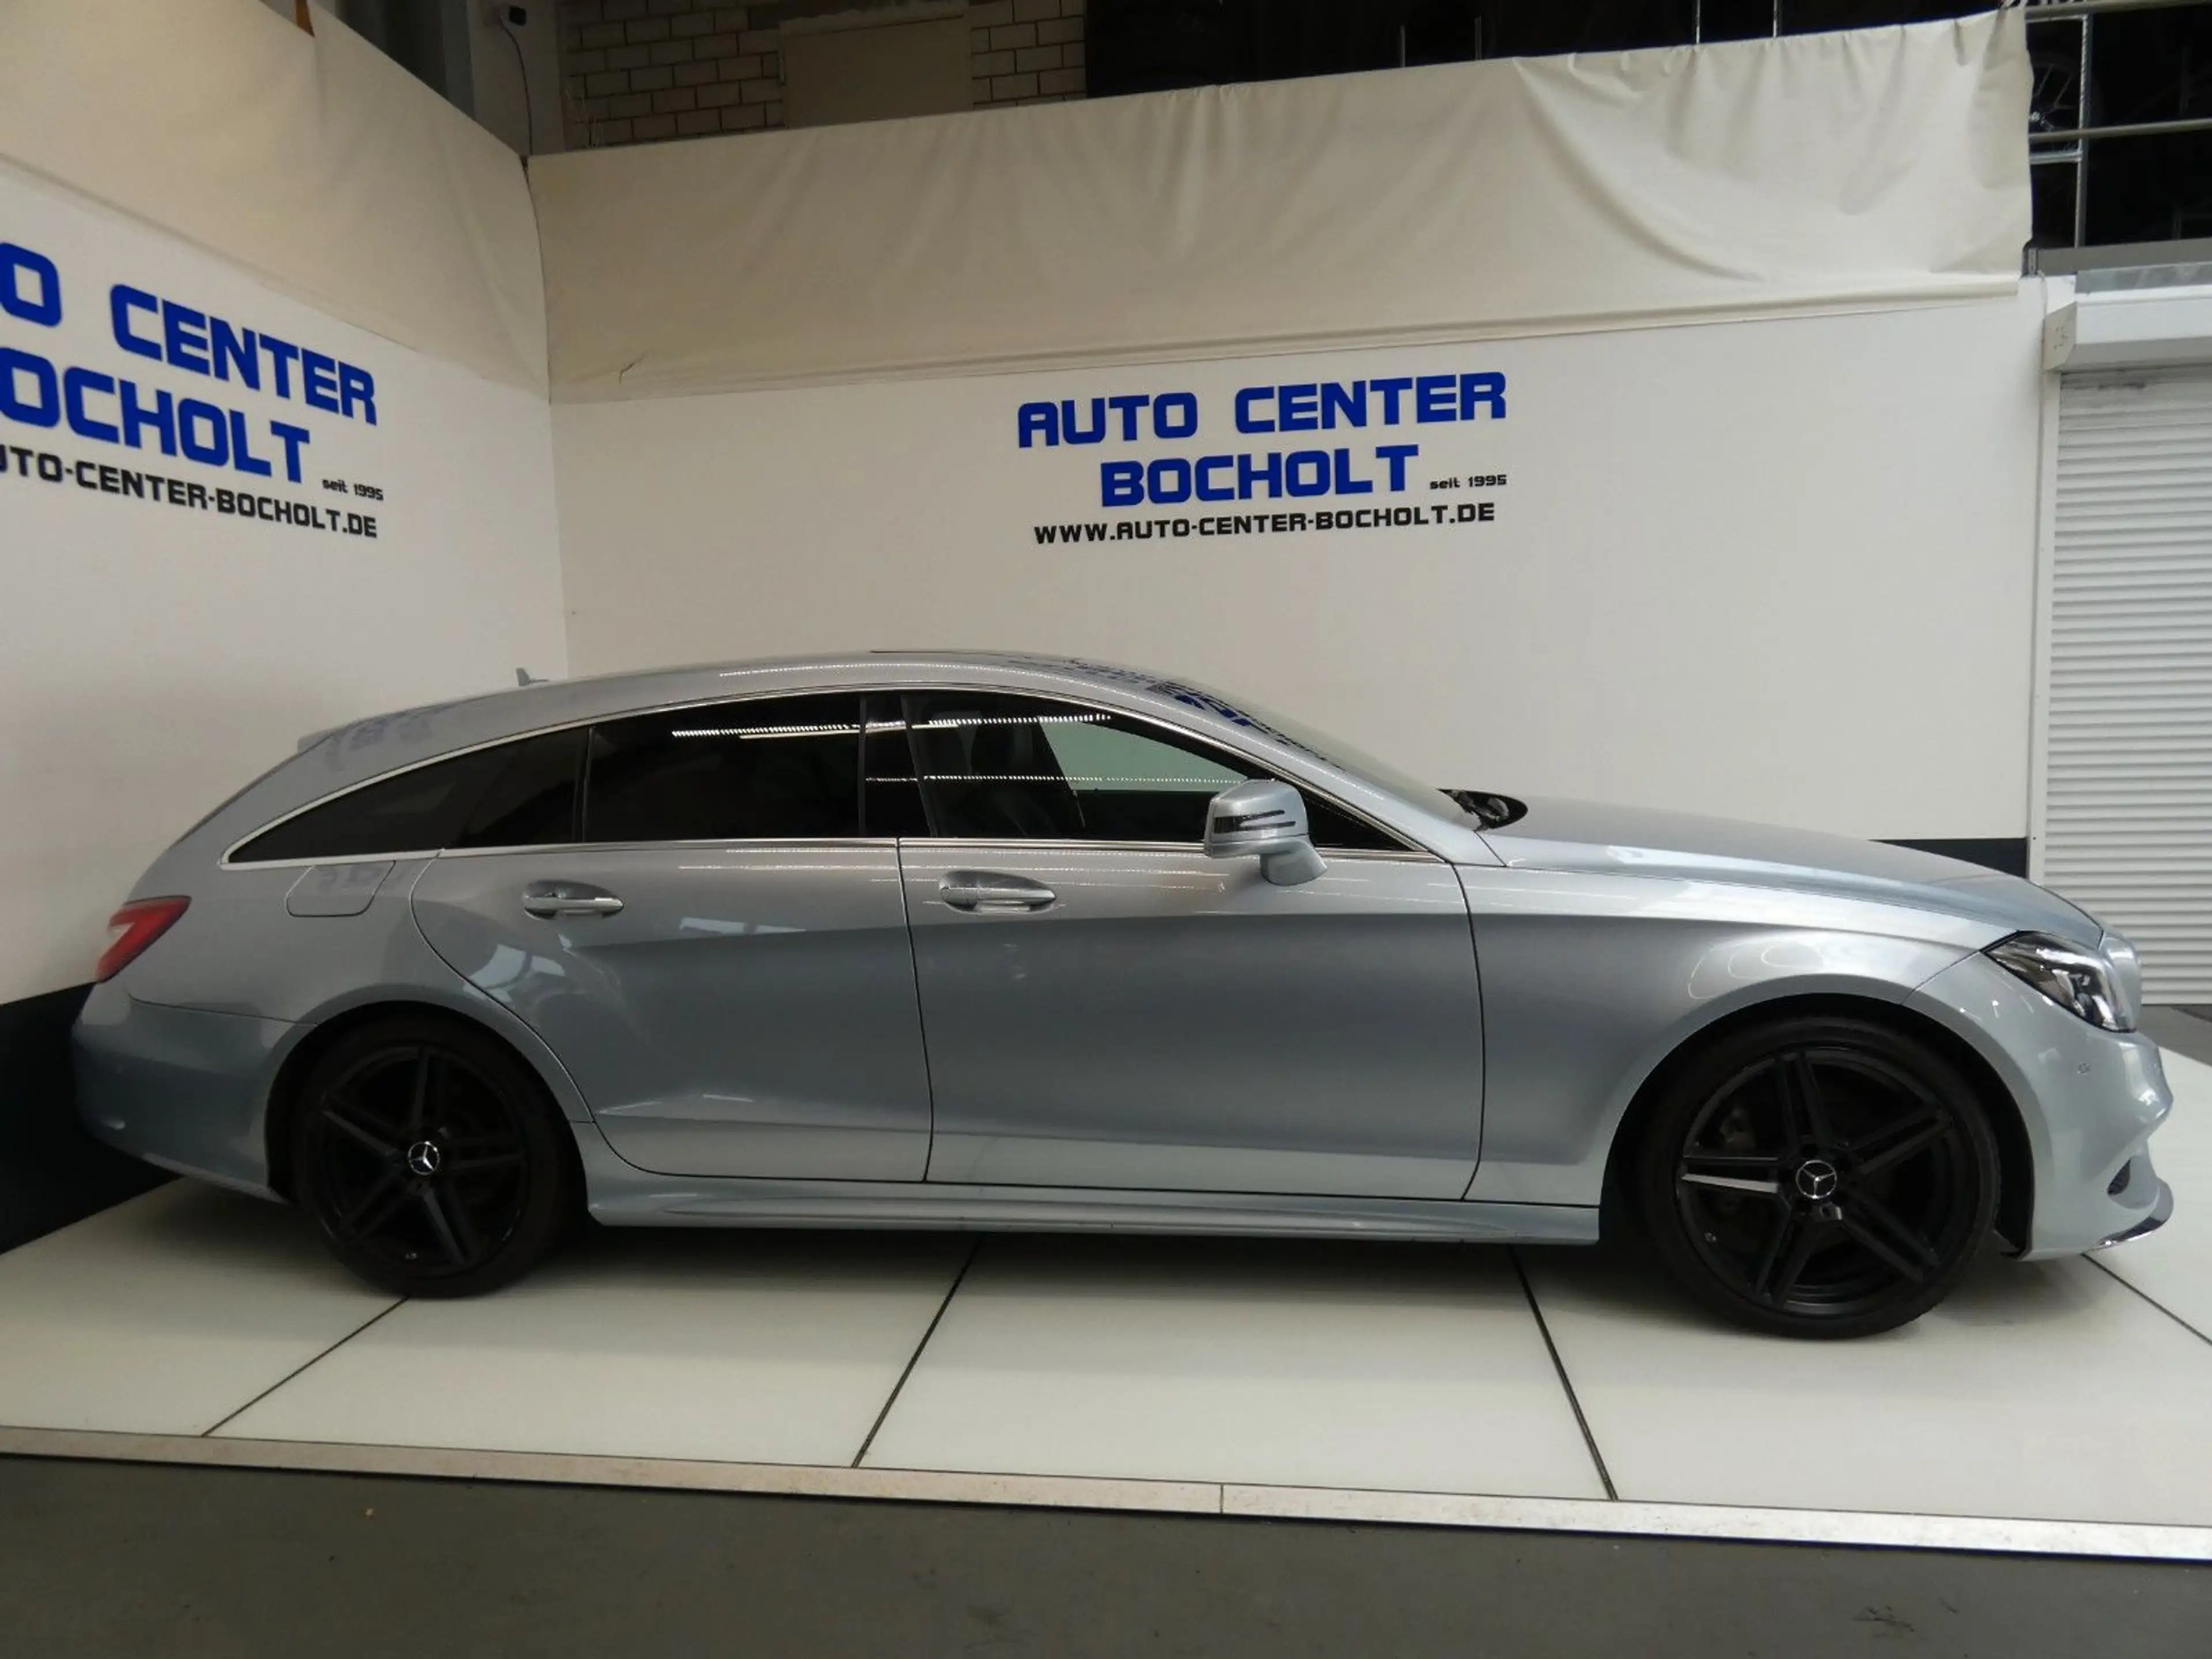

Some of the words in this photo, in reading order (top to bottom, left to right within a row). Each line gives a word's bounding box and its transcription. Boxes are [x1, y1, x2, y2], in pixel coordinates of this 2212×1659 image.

[111, 284, 377, 426] CENTER
[0, 347, 310, 483] OCHOLT
[322, 479, 348, 494] seit
[353, 483, 384, 501] 1995
[1018, 393, 1197, 447] AUTO
[1235, 372, 1506, 433] CENTER
[1101, 445, 1419, 507] BOCHOLT
[1429, 477, 1460, 490] seit
[1468, 474, 1507, 488] 1995
[1034, 503, 1495, 545] WWW.AUTO-CENTER-BOCHOLT.DE
